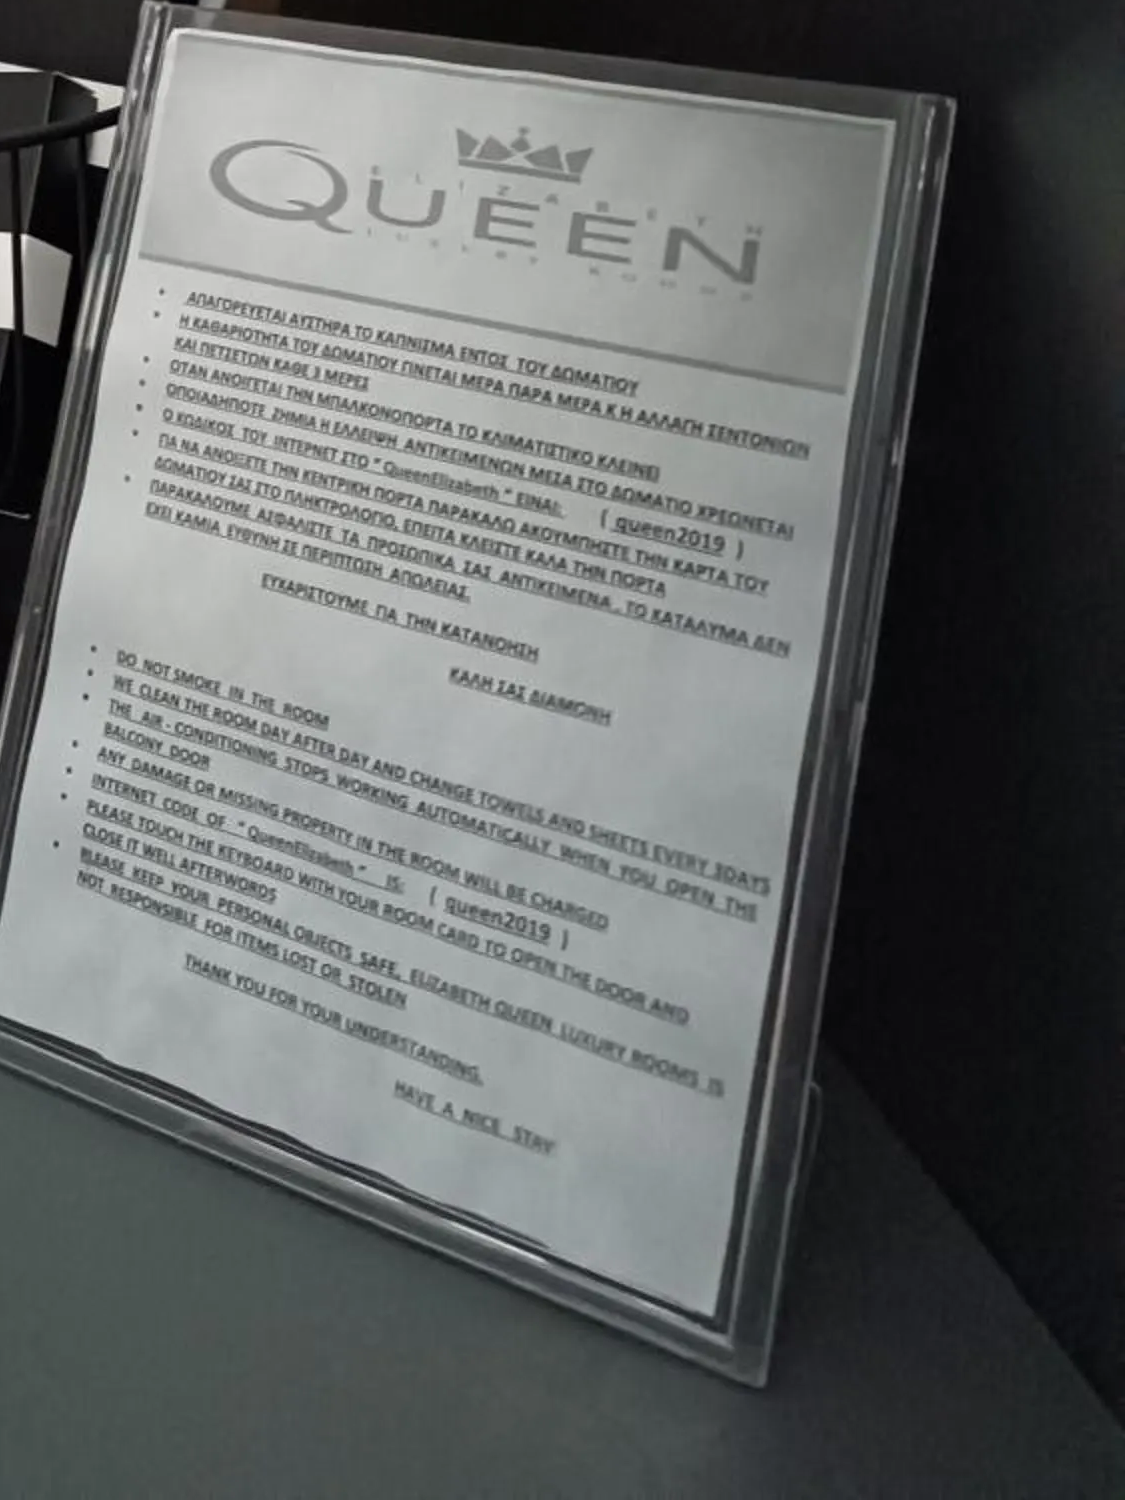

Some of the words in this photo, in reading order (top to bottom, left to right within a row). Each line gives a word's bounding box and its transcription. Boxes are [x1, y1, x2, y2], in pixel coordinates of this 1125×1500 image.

[208, 139, 760, 285] QUEEN
[514, 356, 550, 377] ΤΟΥ
[456, 422, 479, 441] ΤΟ
[613, 512, 727, 556] queen2019
[102, 720, 164, 754] BALCONY
[168, 742, 211, 770] DOOR
[115, 649, 138, 669] DO
[142, 657, 171, 680] NOT
[172, 667, 221, 696] SMOKE
[249, 691, 276, 713] THE
[281, 701, 330, 730] ROOM
[108, 698, 132, 719] THE
[140, 709, 165, 730] AIR
[173, 719, 279, 768] CONDITIONING
[282, 755, 330, 785] STOPS
[336, 772, 411, 811] WORKING
[417, 798, 552, 856] AUTOMATICALLY
[558, 843, 611, 875] WHEN
[617, 861, 657, 890] YOU
[664, 876, 716, 909] OPEN
[724, 895, 758, 922] THE
[137, 682, 182, 710] CLEAN
[184, 697, 209, 718] THE
[211, 706, 257, 734] ROOM
[259, 721, 290, 745] DAY
[292, 731, 335, 759] AFTER
[337, 746, 369, 770] DAY
[372, 756, 407, 781] AND
[408, 768, 474, 803] CHANGE
[548, 810, 586, 838] AND
[81, 821, 124, 850] CLOSE
[140, 842, 177, 869] WELL
[178, 855, 277, 905] AFTERWORDS
[90, 772, 157, 808] INTERNET
[160, 796, 198, 823] CODE
[443, 890, 552, 947] queen2019
[97, 745, 126, 768] ANY
[129, 756, 191, 791] DAMAGE
[192, 777, 216, 799] OR
[217, 786, 280, 821] MISSING
[281, 807, 354, 846] PROPERTY
[376, 839, 407, 864] THE
[409, 850, 461, 882] ROOM
[463, 868, 501, 896] WILL
[504, 881, 527, 905] BE
[529, 890, 610, 933] CHARGED
[76, 869, 104, 893] NOT
[108, 881, 198, 929] RESPONSIBLE
[203, 916, 233, 943] FOR
[233, 928, 279, 960] ITEMS
[281, 946, 318, 975] LOST
[319, 960, 343, 985] OR
[347, 971, 408, 1010] STOLEN
[79, 846, 125, 876] PLEASE
[130, 865, 165, 891] KEEP
[169, 879, 210, 908] YOUR
[215, 896, 290, 938] PERSONAL
[292, 924, 353, 961] OBJECTS
[409, 966, 492, 1012] ELIZABETH
[493, 997, 553, 1035] QUEEN
[559, 1021, 627, 1062] LUXURY
[629, 1047, 700, 1090] ROOMS
[85, 797, 134, 828] PLEASE
[136, 815, 185, 847] TOUCH
[186, 833, 215, 858] THE
[216, 844, 295, 886] KEYBOARD
[296, 872, 334, 900] WITH
[336, 886, 379, 916] YOUR
[380, 901, 434, 936] ROOM
[436, 921, 480, 952] CARD
[483, 937, 507, 962] TO
[509, 946, 558, 980] OPEN
[560, 964, 591, 992] THE
[593, 976, 646, 1011] DOOR
[648, 995, 691, 1027] AND
[183, 952, 232, 986] THANK
[234, 972, 269, 1000] YOU
[268, 985, 298, 1012] FOR
[301, 998, 342, 1029] YOUR
[393, 1079, 435, 1111] HAVE
[461, 1106, 503, 1138] NICE
[512, 1126, 556, 1160] STAY
